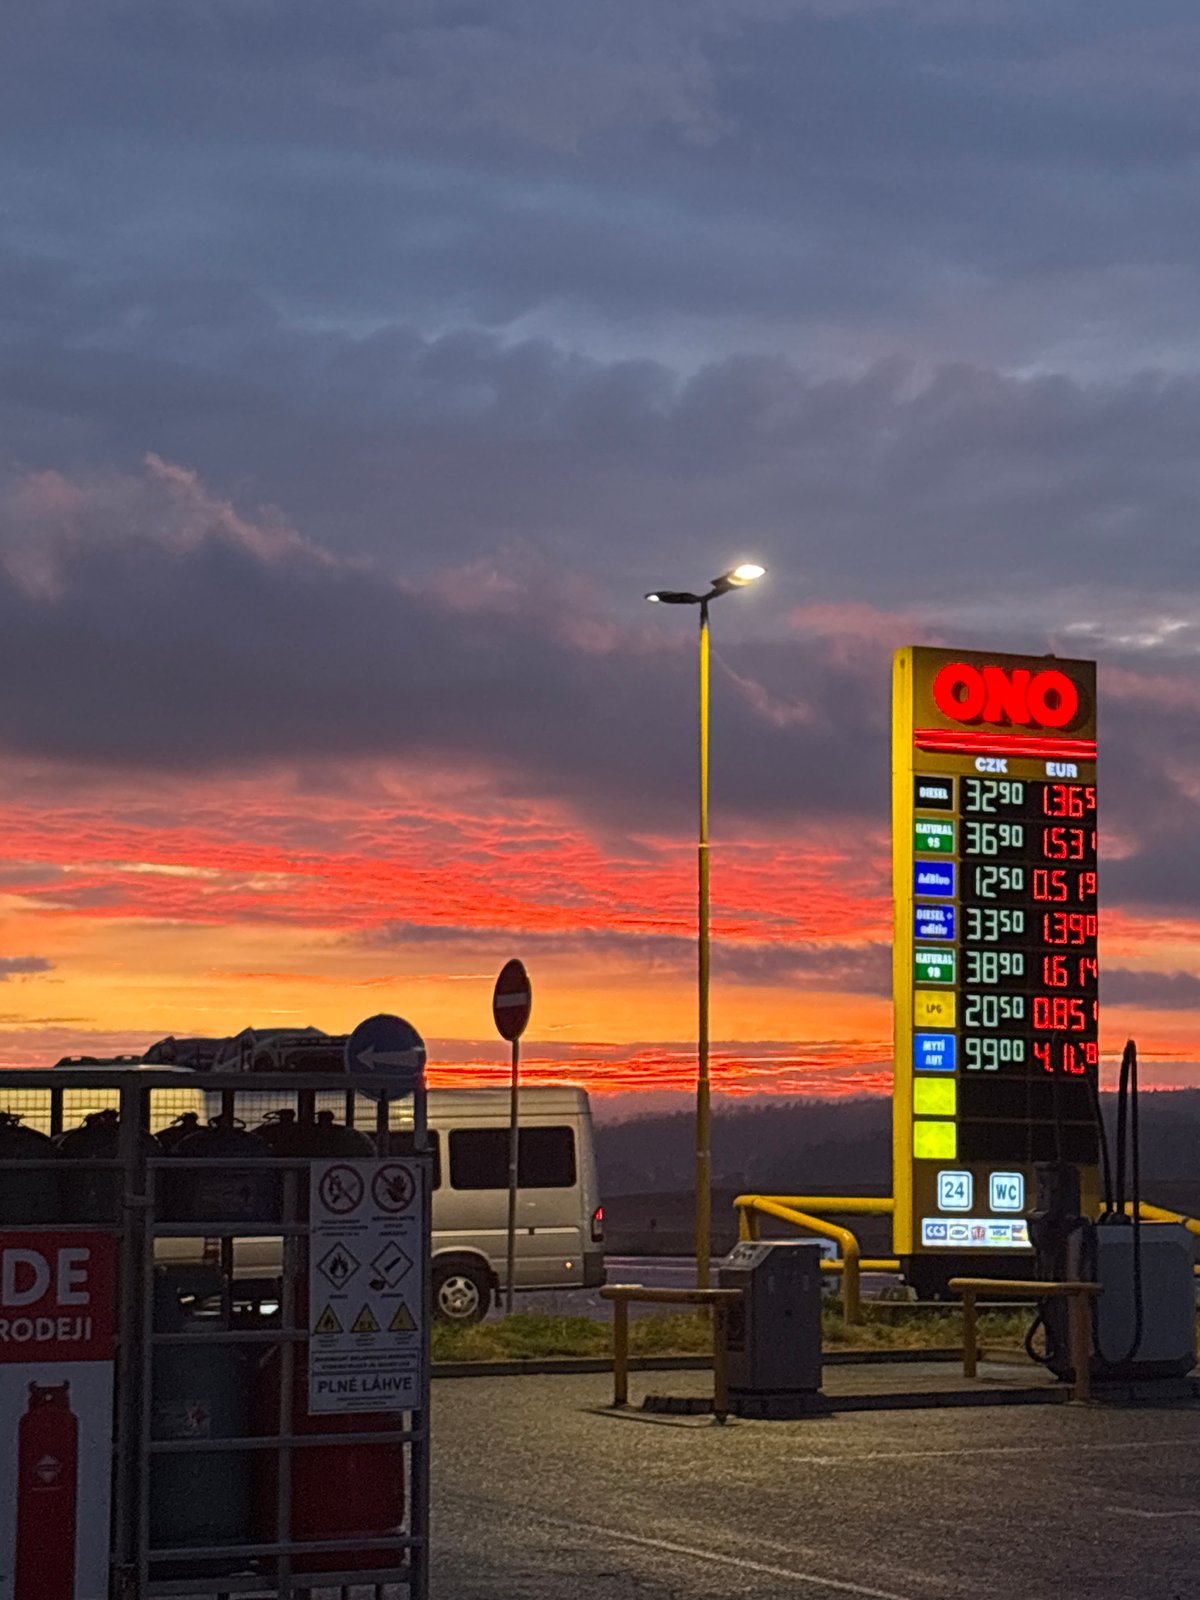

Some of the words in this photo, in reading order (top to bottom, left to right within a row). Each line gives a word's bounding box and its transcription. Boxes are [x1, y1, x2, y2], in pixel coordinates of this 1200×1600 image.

[933, 663, 1079, 728] ONO
[975, 757, 1008, 773] CZK
[1045, 761, 1078, 778] EUR
[919, 786, 949, 800] DIESEL
[927, 837, 941, 849] 95
[917, 872, 951, 886] AdBlue
[916, 908, 946, 921] DIESEL
[915, 952, 954, 965] NATURAL
[926, 1003, 942, 1014] LPG
[944, 1181, 965, 1199] 24
[995, 1184, 1017, 1201] WC
[926, 1225, 946, 1238] CCS
[2, 1247, 91, 1307] DE
[317, 1376, 358, 1394] PLNÉ
[362, 1373, 413, 1392] LÁHVE
